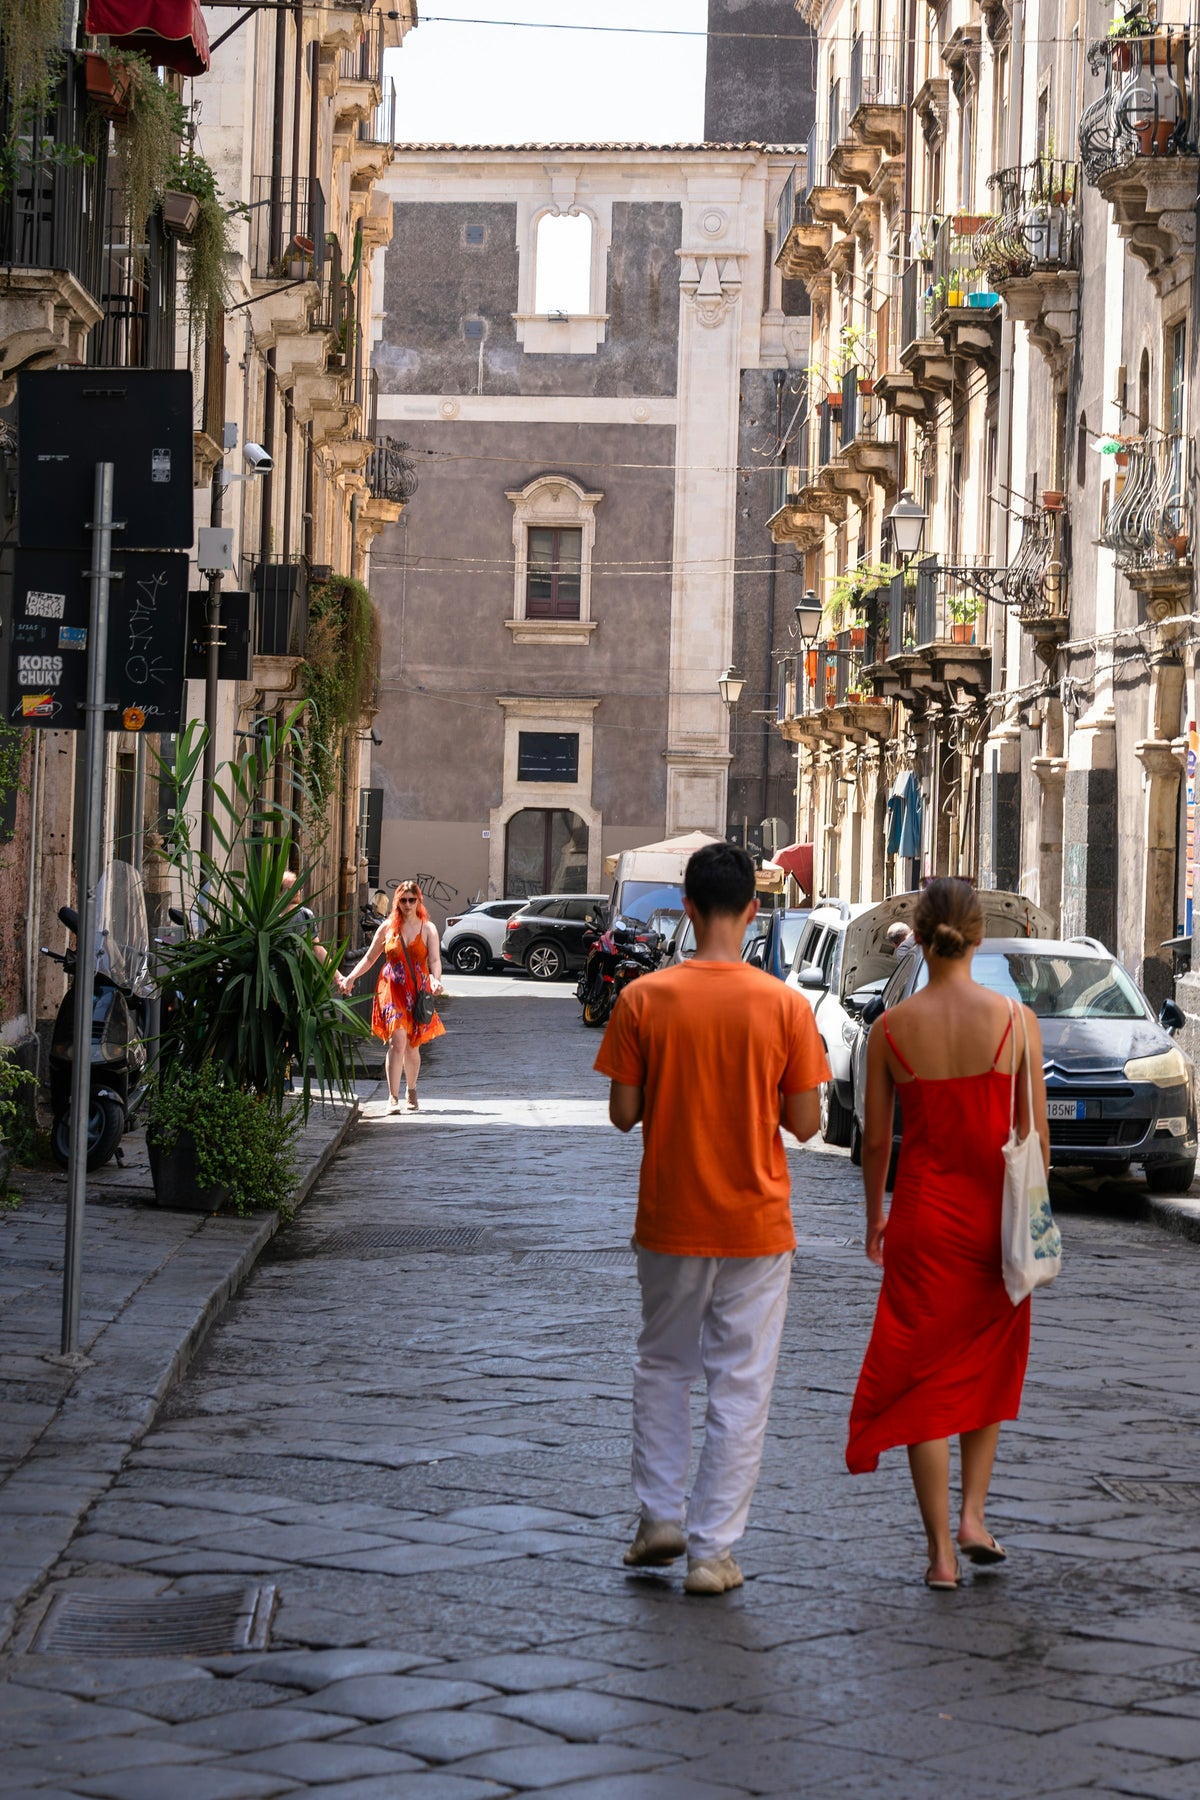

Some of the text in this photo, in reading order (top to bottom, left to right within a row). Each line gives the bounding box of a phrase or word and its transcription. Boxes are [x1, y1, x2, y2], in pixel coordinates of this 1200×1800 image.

[18, 655, 63, 671] KORS
[18, 670, 63, 686] CHUKY
[1047, 1103, 1076, 1117] 185NP
